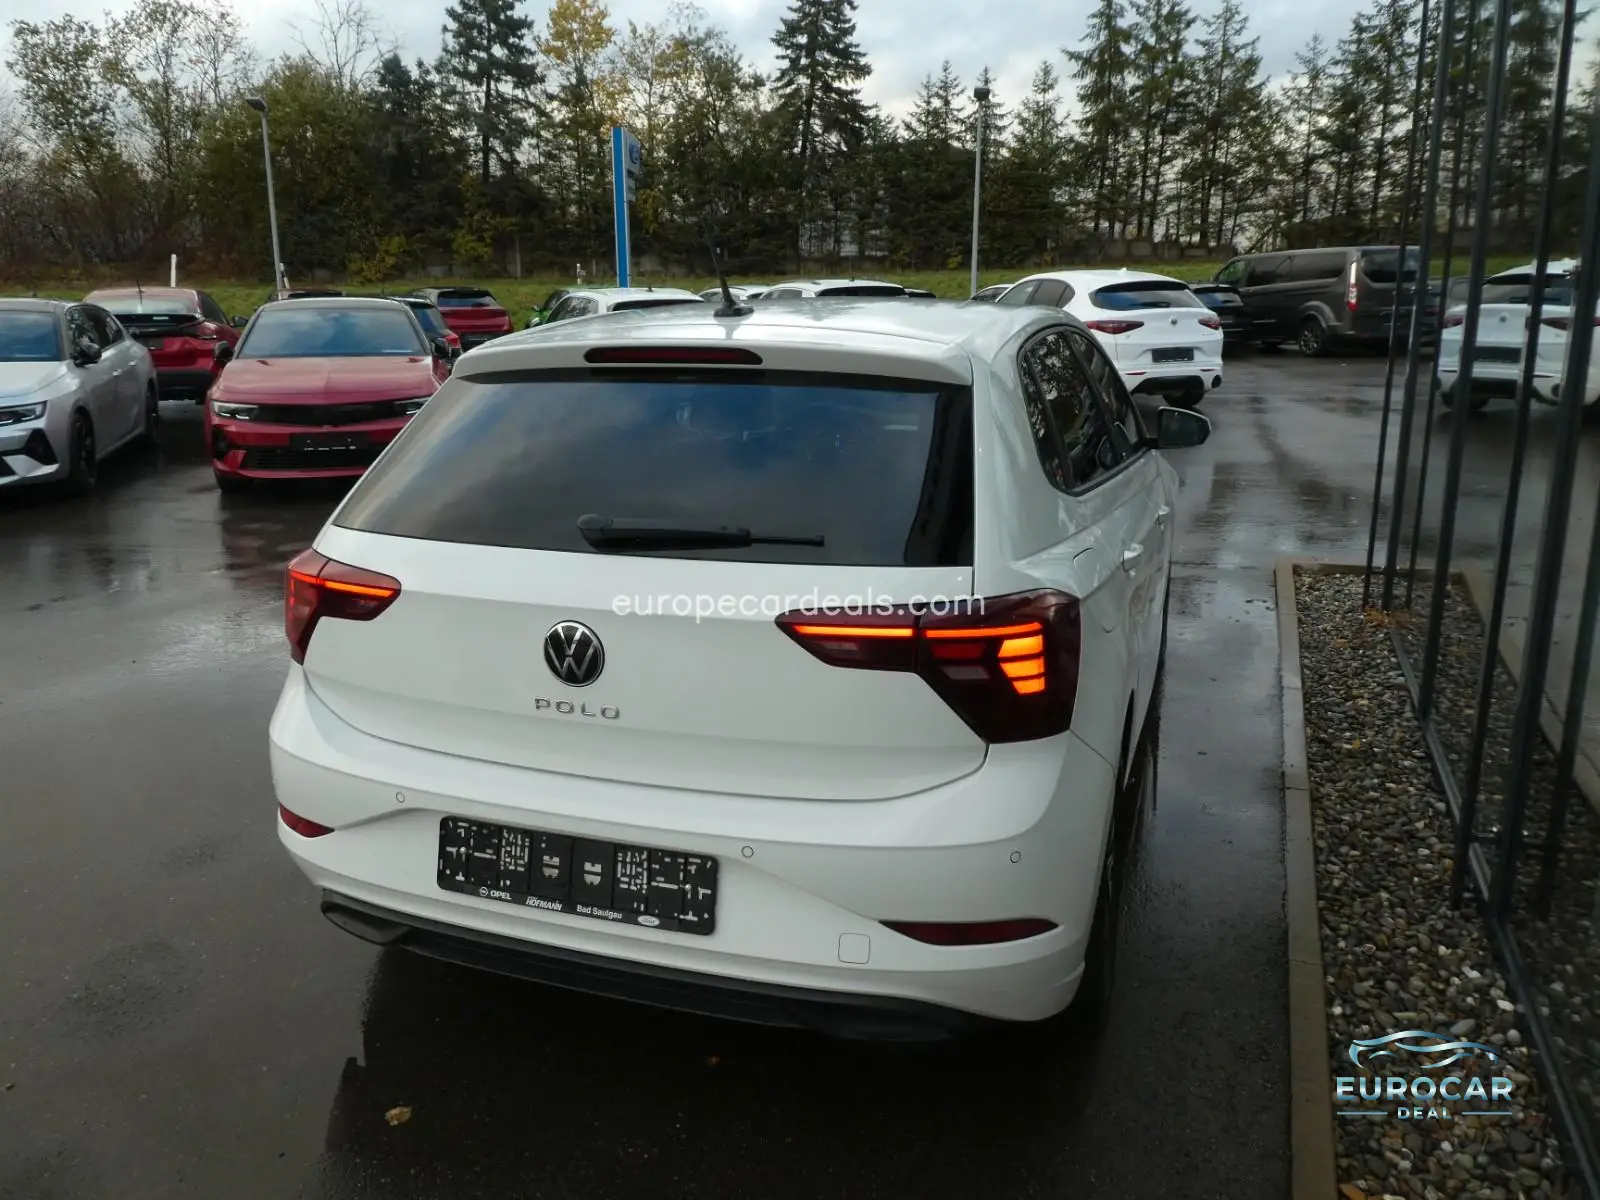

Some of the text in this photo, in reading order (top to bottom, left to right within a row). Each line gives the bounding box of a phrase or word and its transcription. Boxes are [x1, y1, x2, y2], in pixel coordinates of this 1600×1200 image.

[534, 696, 620, 719] POLO
[490, 890, 512, 900] OPEL
[576, 904, 591, 914] Bad
[592, 907, 622, 919] Saulgau
